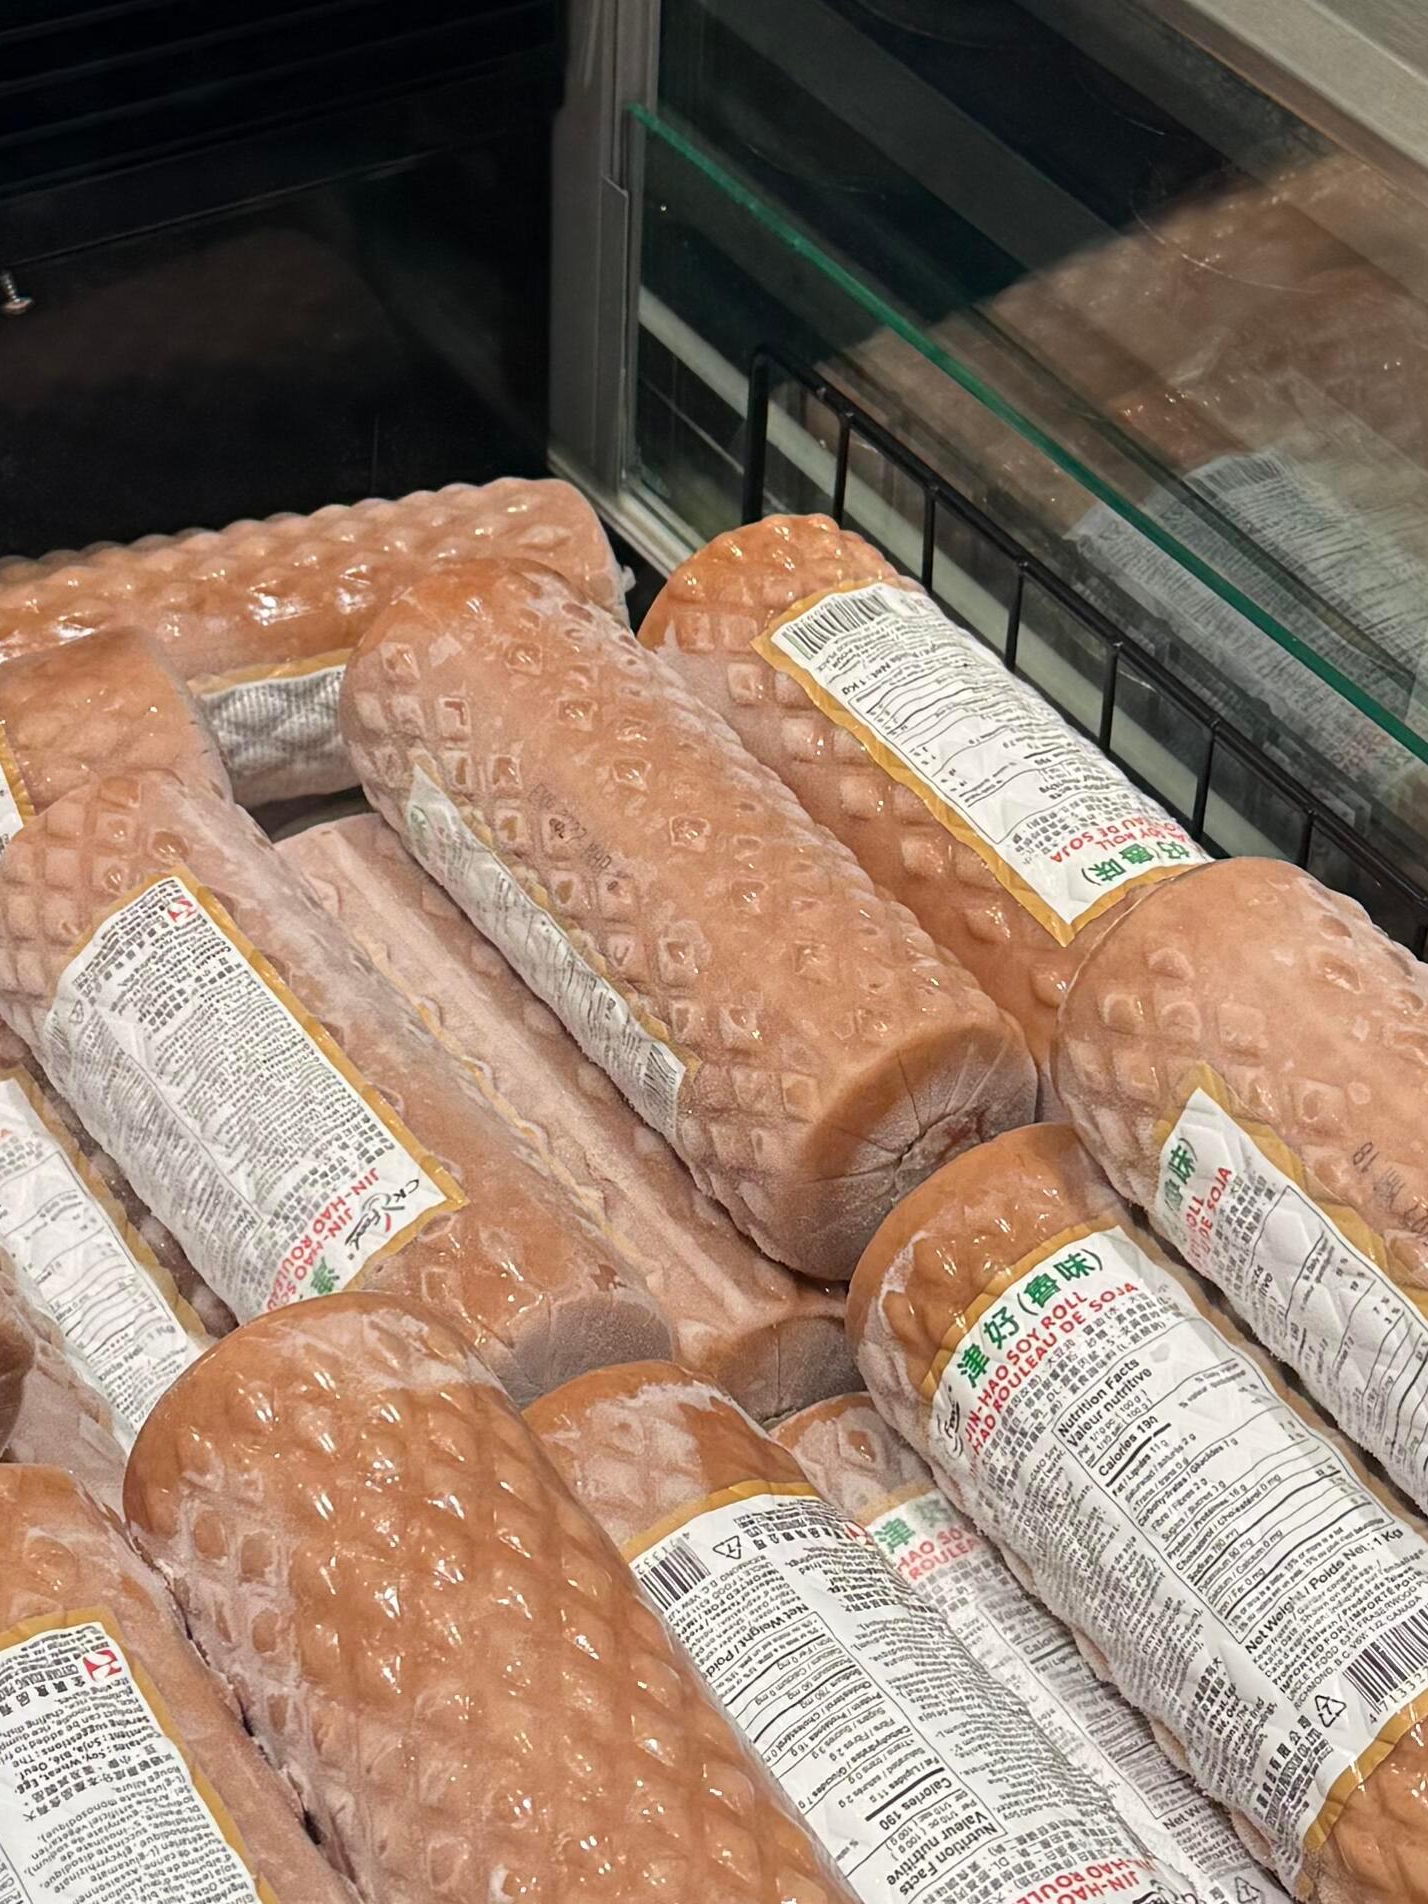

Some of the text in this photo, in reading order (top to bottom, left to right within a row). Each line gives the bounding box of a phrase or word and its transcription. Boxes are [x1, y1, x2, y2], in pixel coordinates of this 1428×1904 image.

[309, 1166, 381, 1235] JIN-HAO
[291, 1207, 354, 1281] JIN-HAO
[960, 1287, 1088, 1444] JIN-HAO SOY ROLL
[987, 1277, 1139, 1413] ROULEAU DE SOJA
[1056, 1355, 1140, 1438] Nutrition Facts
[900, 1774, 952, 1815] Calories
[883, 1835, 942, 1887] nutritive
[897, 1820, 997, 1897] Nutrition Facts
